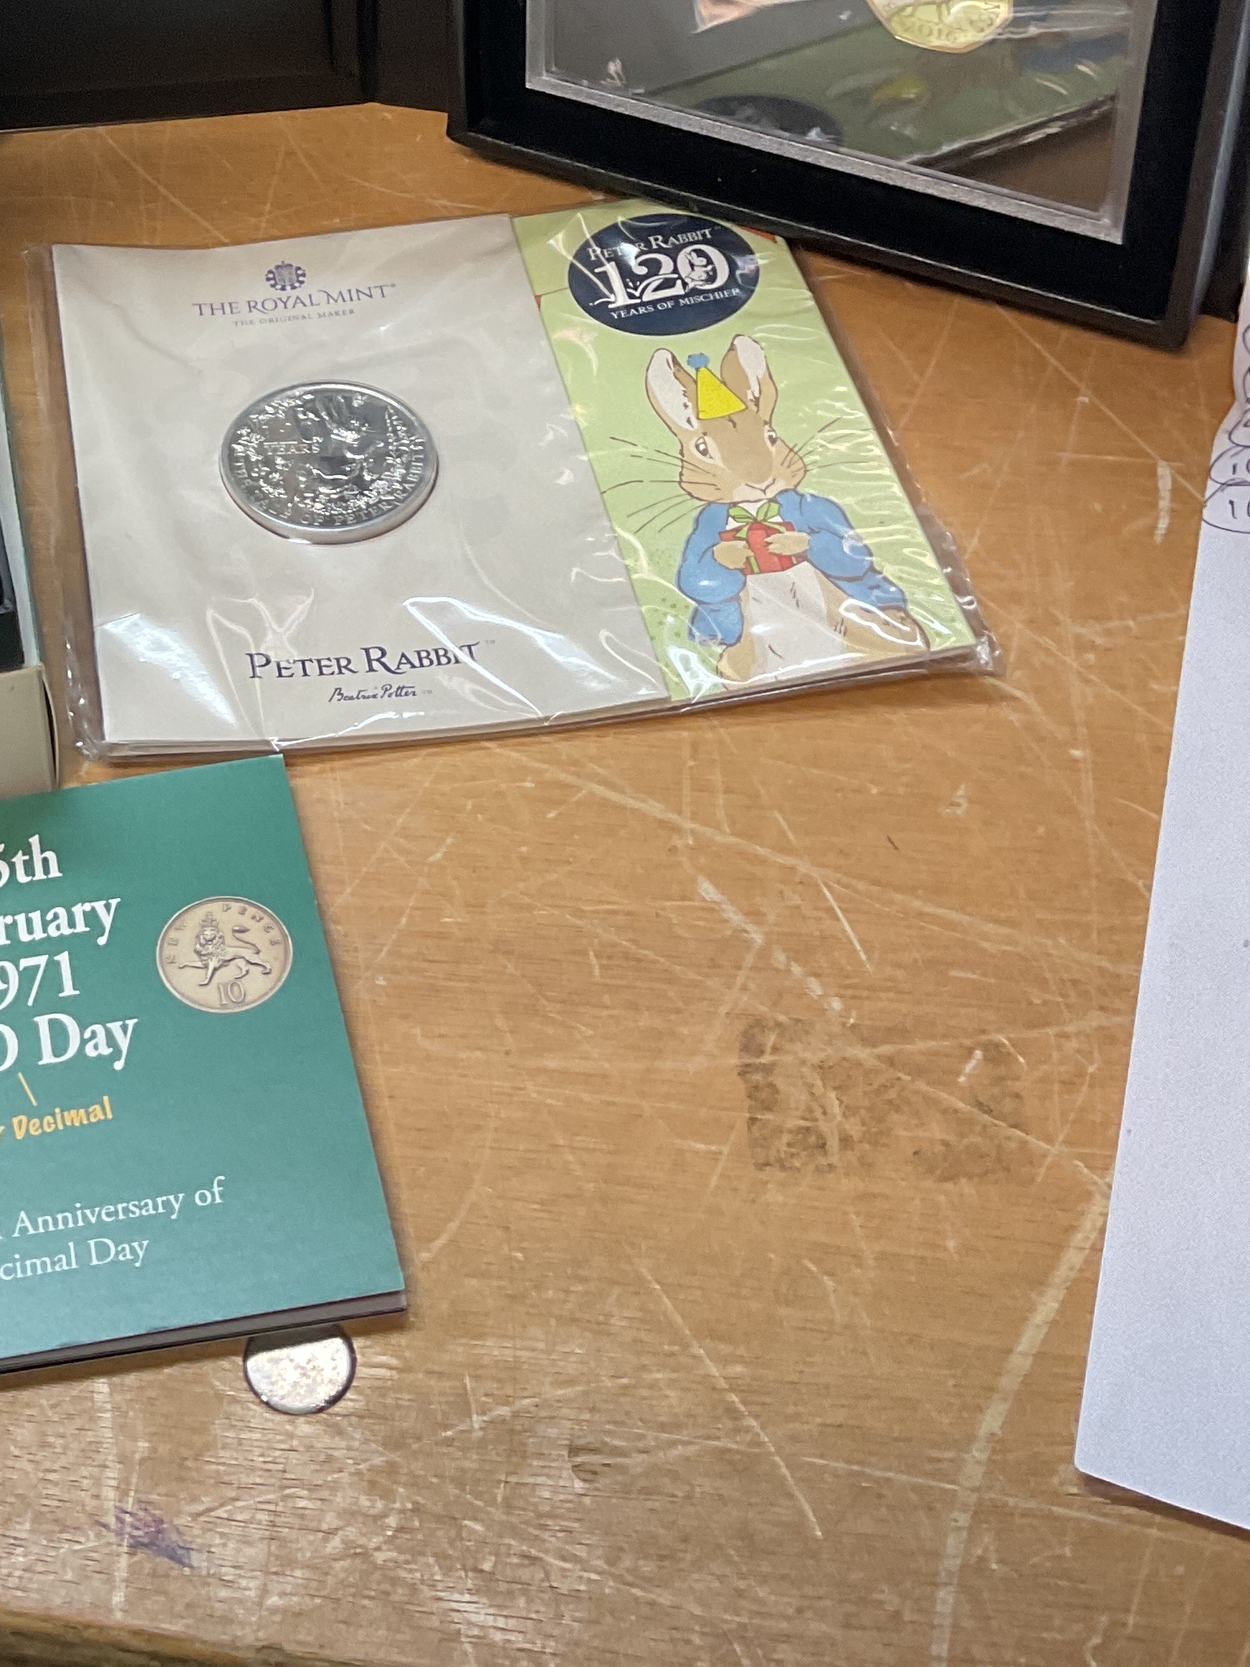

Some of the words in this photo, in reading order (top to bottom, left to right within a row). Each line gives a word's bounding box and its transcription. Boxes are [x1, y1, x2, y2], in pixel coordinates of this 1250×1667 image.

[586, 242, 647, 262] PETR
[648, 226, 713, 250] RABBIT
[592, 243, 730, 309] 120
[192, 300, 241, 318] THE
[247, 292, 321, 315] ROYAL
[259, 312, 314, 326] ORIGINAL
[317, 308, 356, 320] MAKER
[610, 304, 655, 320] YEARS
[657, 299, 676, 311] OF
[679, 287, 742, 307] MISCHIEF
[263, 443, 321, 456] YEARS
[244, 652, 359, 679] PETER
[380, 683, 418, 698] Potter
[217, 980, 246, 1007] 10
[36, 1014, 139, 1070] Day
[12, 1097, 114, 1142] Decimal
[11, 1188, 187, 1238] Anniversary
[193, 1175, 227, 1207] of
[88, 1237, 150, 1270] Day
